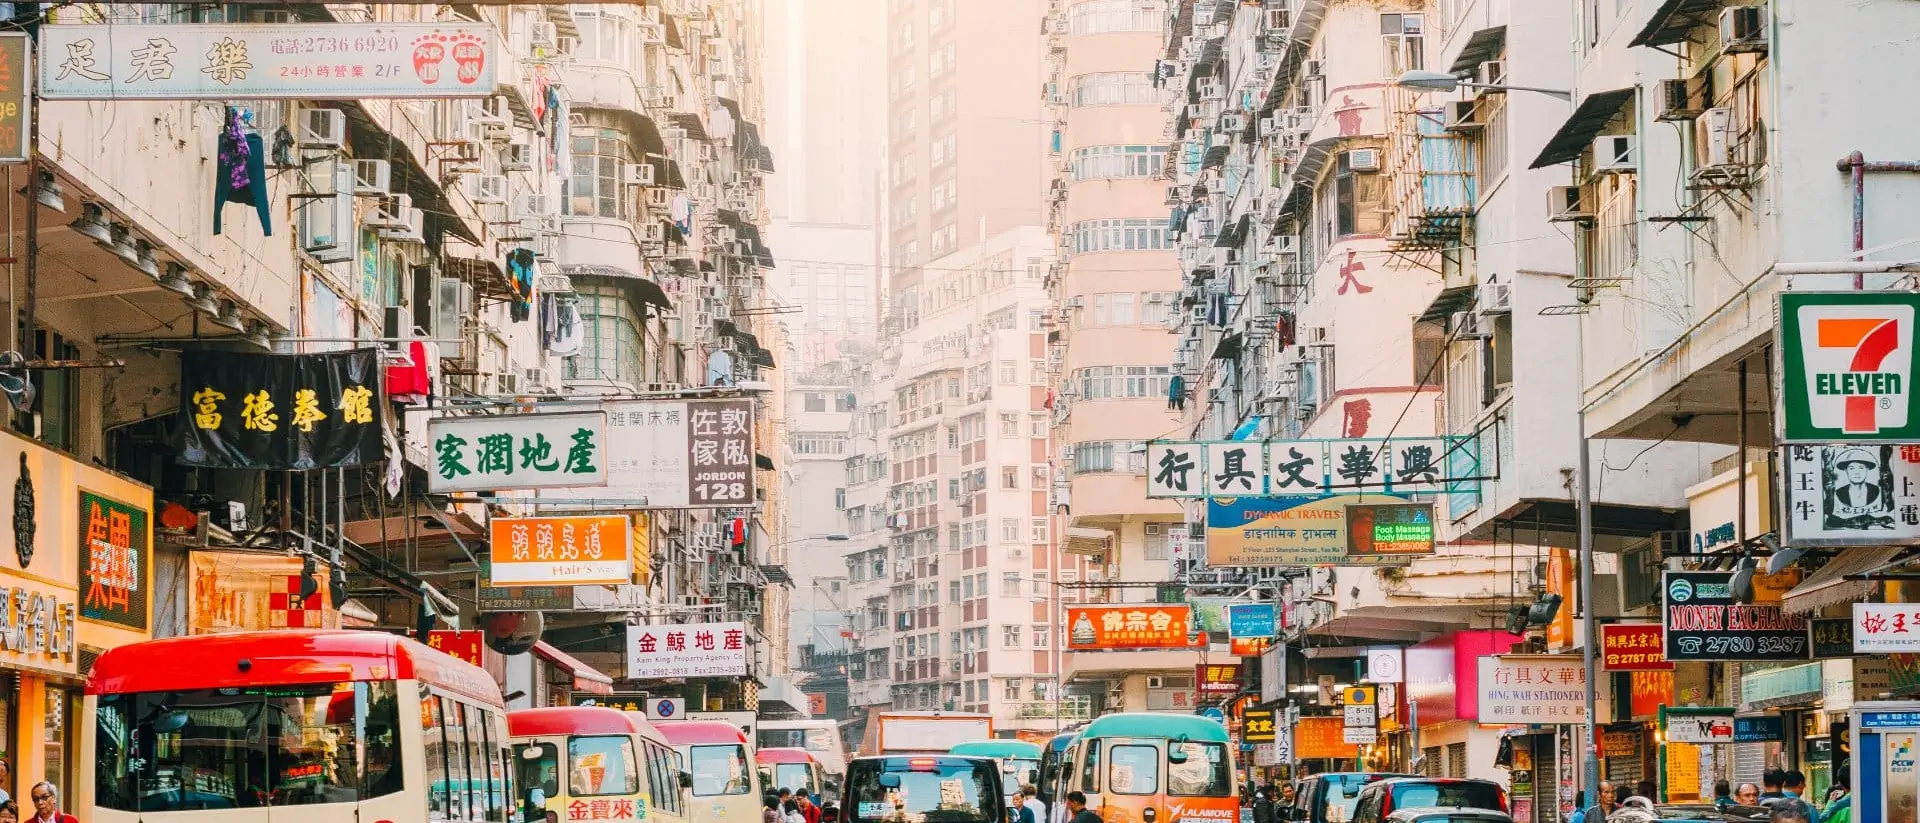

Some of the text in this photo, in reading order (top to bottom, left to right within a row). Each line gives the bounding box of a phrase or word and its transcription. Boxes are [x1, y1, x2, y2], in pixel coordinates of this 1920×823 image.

[354, 37, 399, 53] 6920
[55, 37, 254, 85] 足君樂
[375, 64, 400, 78] 2/F
[193, 385, 373, 432] 富德拳館
[690, 408, 749, 435] 佐敦
[435, 427, 597, 480] 家潤地產
[690, 439, 749, 466] 傢俬
[694, 471, 746, 481] JORDON
[694, 483, 746, 500] 128
[1243, 510, 1340, 519] DYNAMIC TRAVELS
[1375, 526, 1393, 534] Foot
[1375, 534, 1395, 542] Body
[552, 564, 592, 575] Hair's
[1670, 604, 1724, 631] MONEY
[1706, 637, 1806, 653] 2780 3287
[1621, 654, 1645, 663] 2787
[1488, 690, 1508, 700] HING
[1513, 690, 1531, 700] WAH
[1534, 690, 1585, 700] STATIONERY
[568, 798, 633, 820] 金寶來
[1181, 808, 1233, 818] LALAMOVE
